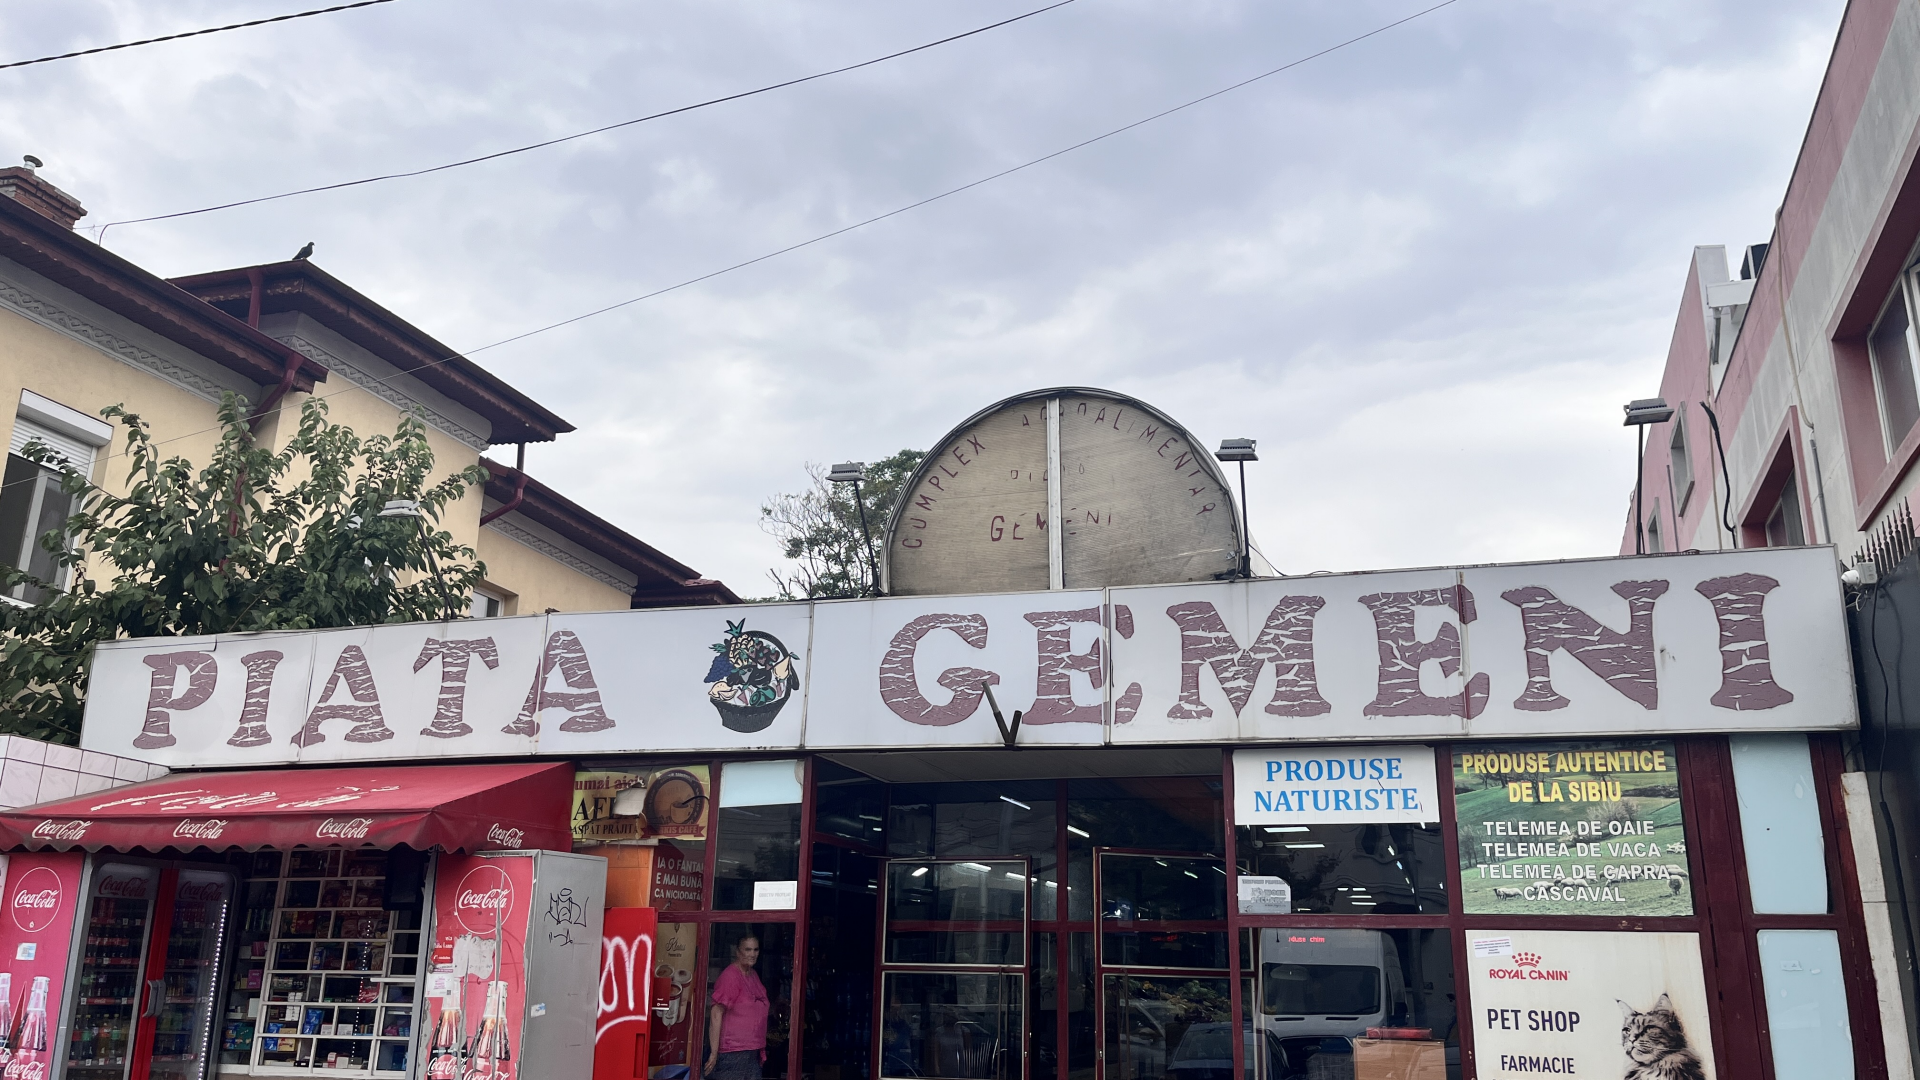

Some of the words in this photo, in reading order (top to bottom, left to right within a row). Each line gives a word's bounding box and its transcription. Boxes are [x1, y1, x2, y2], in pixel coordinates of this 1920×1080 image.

[132, 629, 617, 749] PIATA
[879, 573, 1794, 727] GEMENI
[1265, 757, 1403, 782] PRODUSE
[1462, 751, 1550, 774] PRODUSE
[1555, 750, 1667, 773] AUTENTICE
[1253, 788, 1419, 812] NATURISTE
[1508, 781, 1534, 803] DE
[1538, 781, 1564, 803] LA
[1568, 780, 1622, 803] SIBIU
[1483, 820, 1571, 836] TELEMEA
[1577, 820, 1603, 836] DE
[1608, 820, 1655, 836] OAIE
[1481, 842, 1570, 857] TELEMEA
[1577, 842, 1602, 857] DE
[1607, 842, 1661, 857] VACA
[657, 856, 666, 869] IA
[668, 858, 675, 870] O
[1476, 864, 1566, 879] TELEMEA
[1571, 864, 1597, 879] DE
[1603, 865, 1671, 880] CAPRA
[656, 872, 662, 884] E
[663, 873, 679, 886] MAI
[1523, 886, 1626, 902] CASCAVAL
[1489, 968, 1527, 980] ROYAL
[1528, 969, 1569, 981] CANIN
[1487, 1008, 1521, 1030] PET
[1527, 1010, 1580, 1033] SHOP
[1500, 1054, 1576, 1074] FARMACIE
